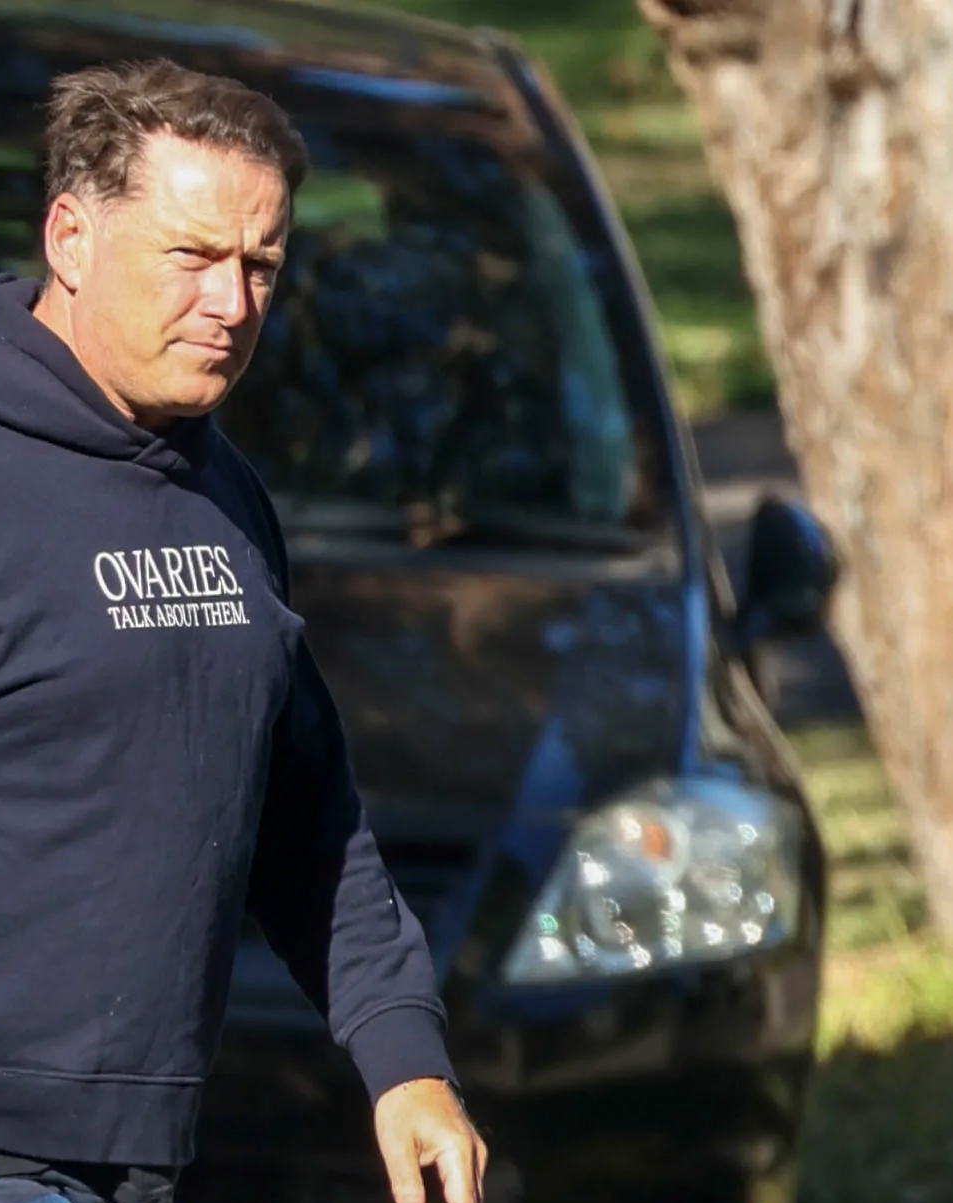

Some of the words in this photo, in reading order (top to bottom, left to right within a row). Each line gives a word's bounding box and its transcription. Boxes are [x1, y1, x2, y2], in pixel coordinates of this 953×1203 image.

[94, 545, 244, 601] OVARIES.
[107, 604, 155, 630] TALK
[157, 602, 200, 627] ABOUT
[200, 601, 251, 627] THEM.
